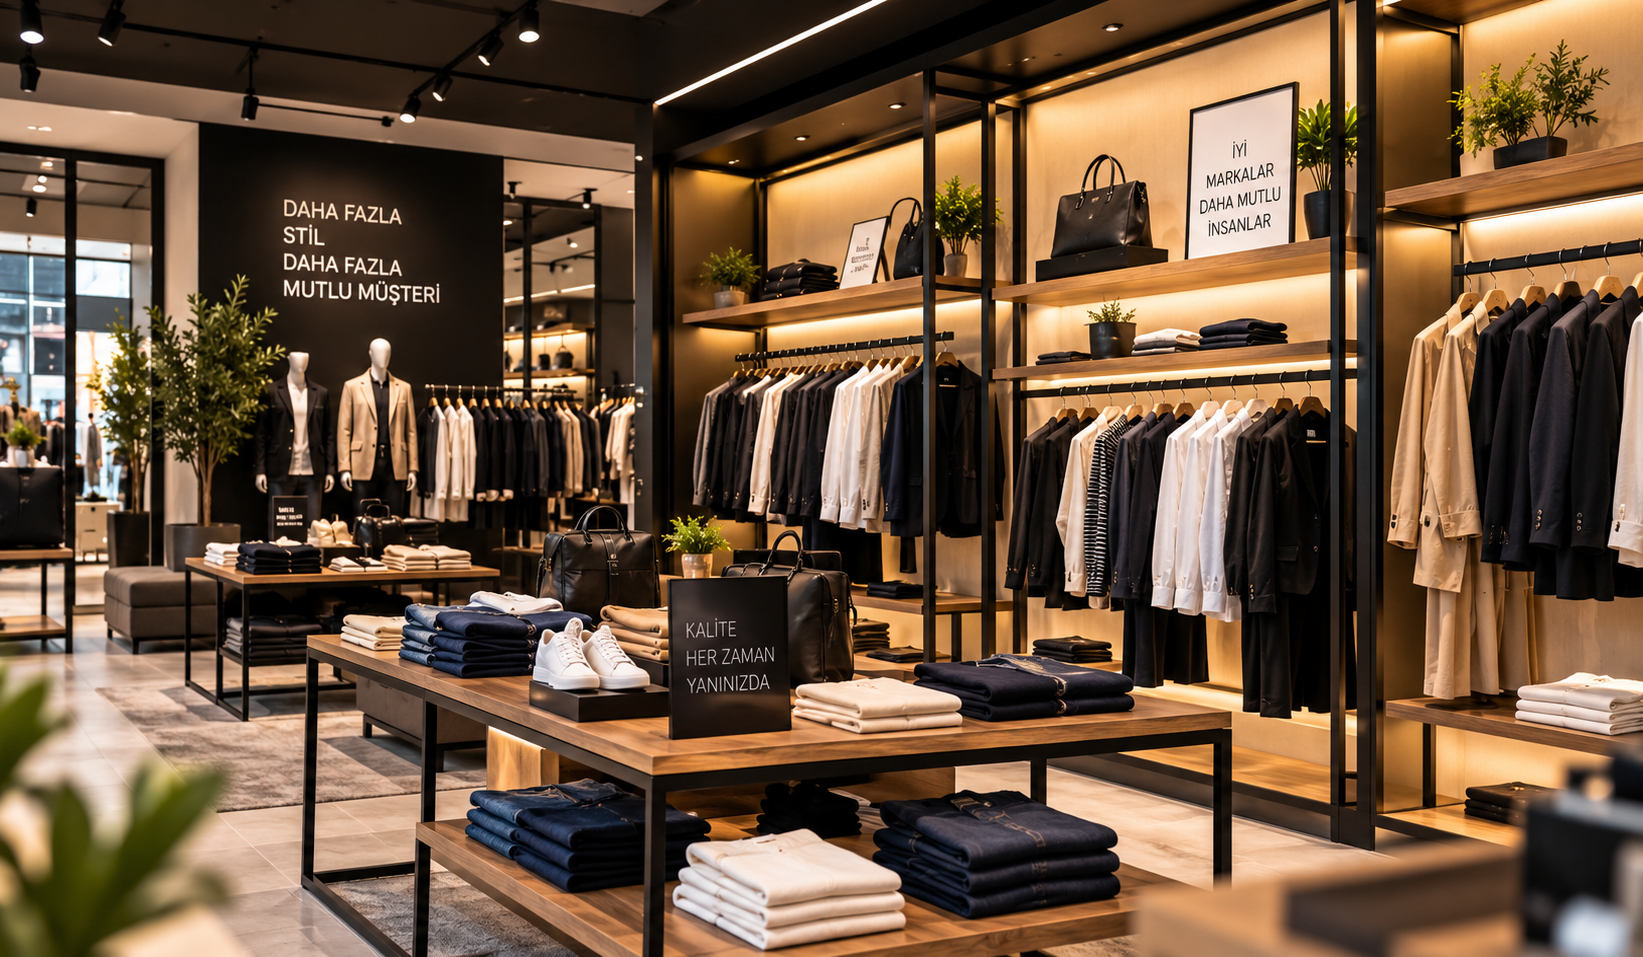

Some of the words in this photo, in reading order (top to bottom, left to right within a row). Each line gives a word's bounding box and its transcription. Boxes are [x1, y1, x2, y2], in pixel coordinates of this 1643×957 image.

[1232, 139, 1247, 159] İYİ
[1206, 162, 1275, 189] MARKALAR
[283, 199, 339, 221] DAHA
[345, 204, 402, 225] FAZLA
[1199, 195, 1234, 215] DAHA
[1237, 186, 1281, 207] MUTLU
[283, 224, 326, 246] STİL
[1208, 213, 1272, 237] İNSANLAR
[283, 253, 339, 273] DAHA
[345, 257, 402, 277] FAZLA
[283, 280, 352, 300] MUTLU
[358, 281, 440, 306] MÜŞTERİ
[685, 617, 737, 639] KALİTE
[686, 649, 717, 667] HER
[721, 646, 775, 664] ZAMAN
[686, 673, 771, 694] YANINIZDA
